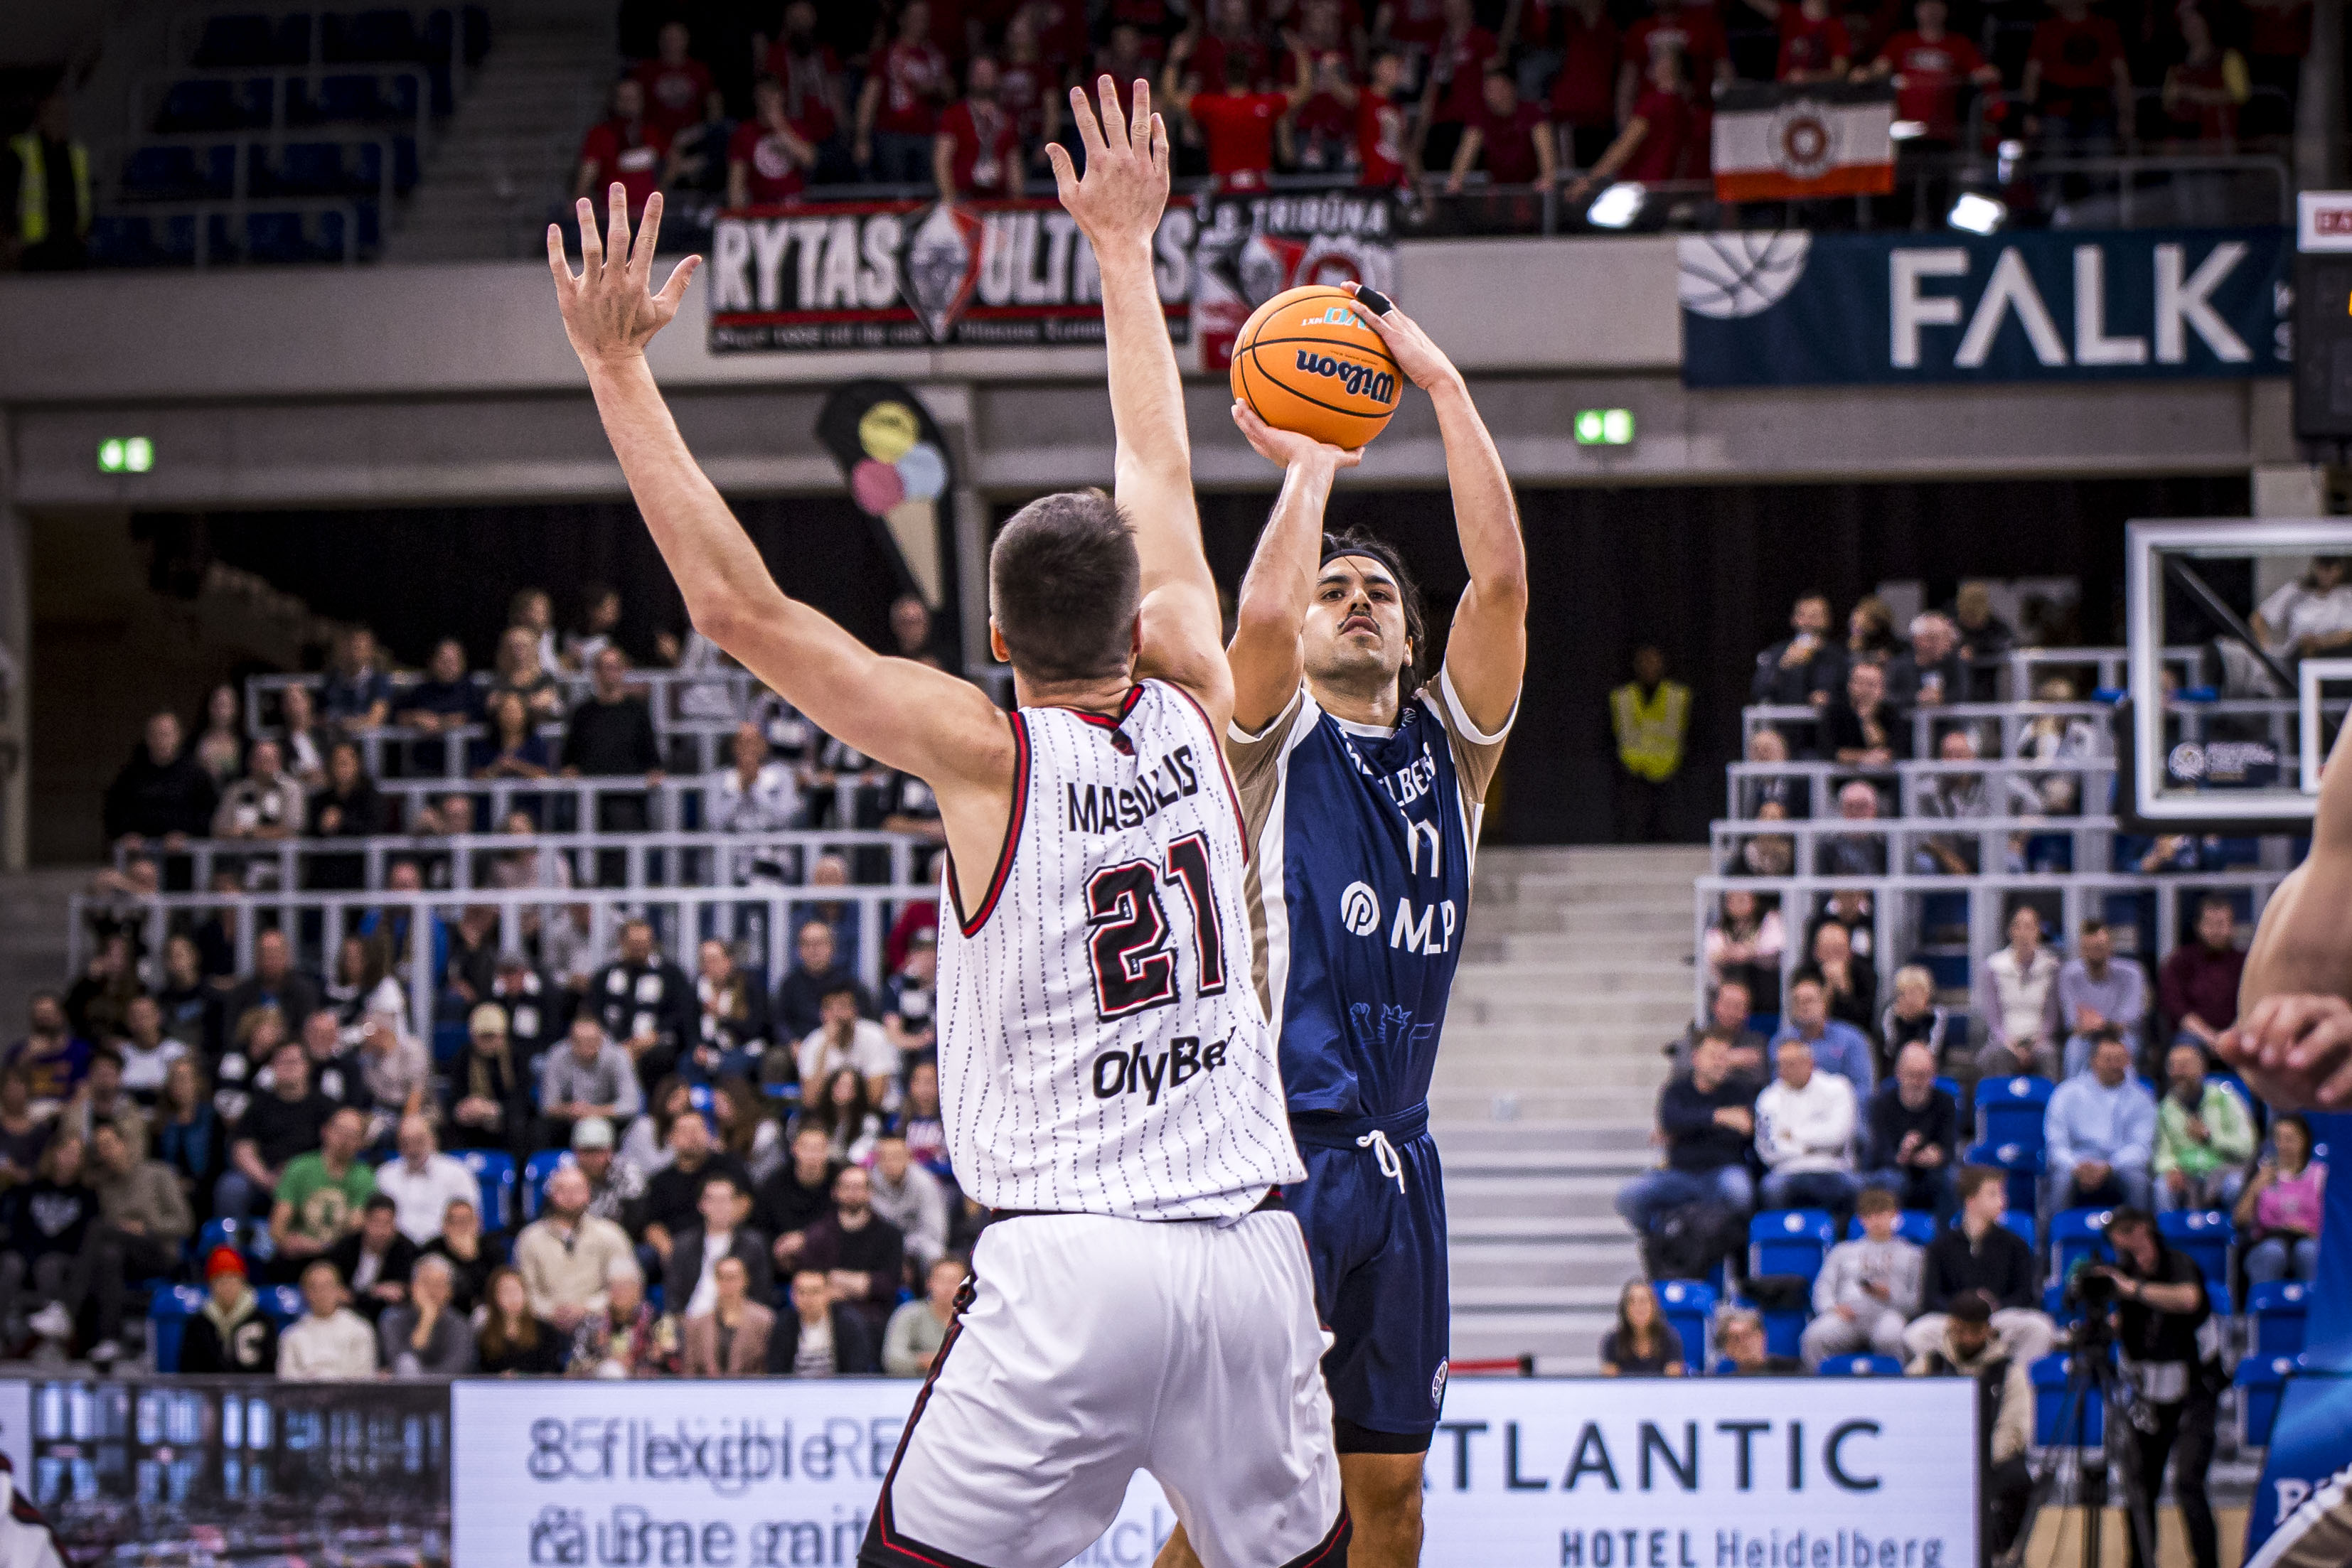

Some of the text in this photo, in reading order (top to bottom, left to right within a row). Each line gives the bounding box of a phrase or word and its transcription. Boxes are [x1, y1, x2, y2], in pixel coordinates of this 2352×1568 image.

[712, 213, 903, 309] RYTAS
[1888, 243, 2252, 368] FALK
[1295, 349, 1396, 405] Wilson
[1082, 829, 1228, 1022] 21
[1390, 897, 1455, 955] MLP
[1421, 1419, 1884, 1493] TLANTIC
[1560, 1528, 1945, 1568] HOTEL Heidelberg
